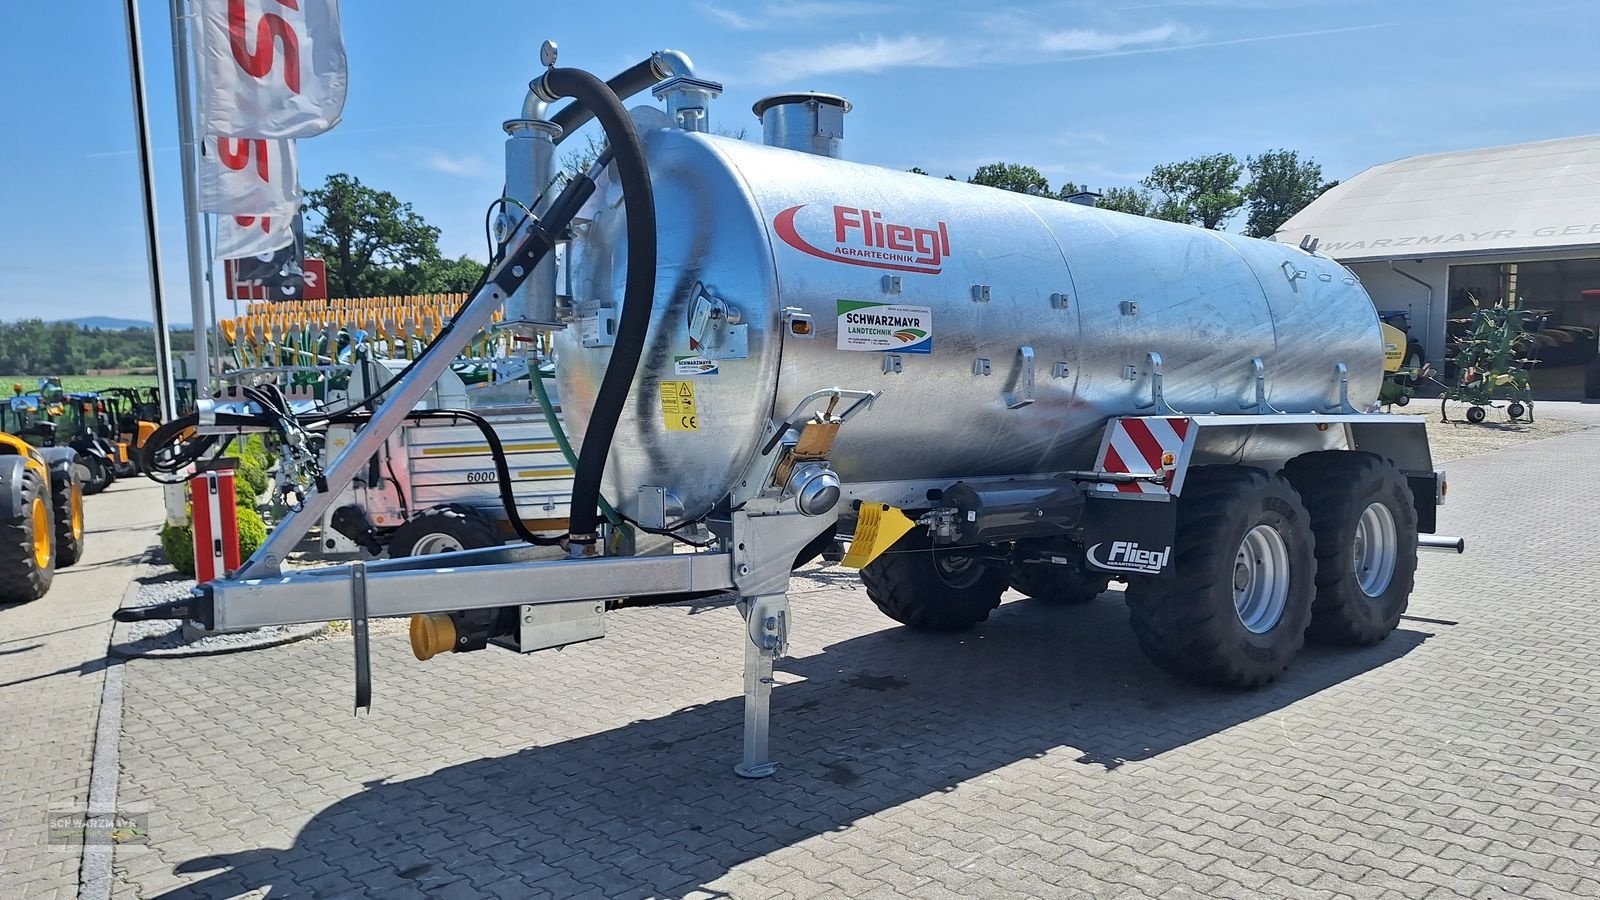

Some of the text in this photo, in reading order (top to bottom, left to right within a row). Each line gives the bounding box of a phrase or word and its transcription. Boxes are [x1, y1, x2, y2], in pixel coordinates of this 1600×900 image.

[833, 205, 950, 266] Fliegl
[1316, 229, 1518, 251] WARZMAYR
[834, 246, 914, 263] AGRARTECHNIK
[846, 312, 920, 328] SCHWARZMAYR
[848, 327, 892, 336] LANDTECHNIK
[467, 471, 495, 482] 6000
[1108, 541, 1171, 570] Fliegl
